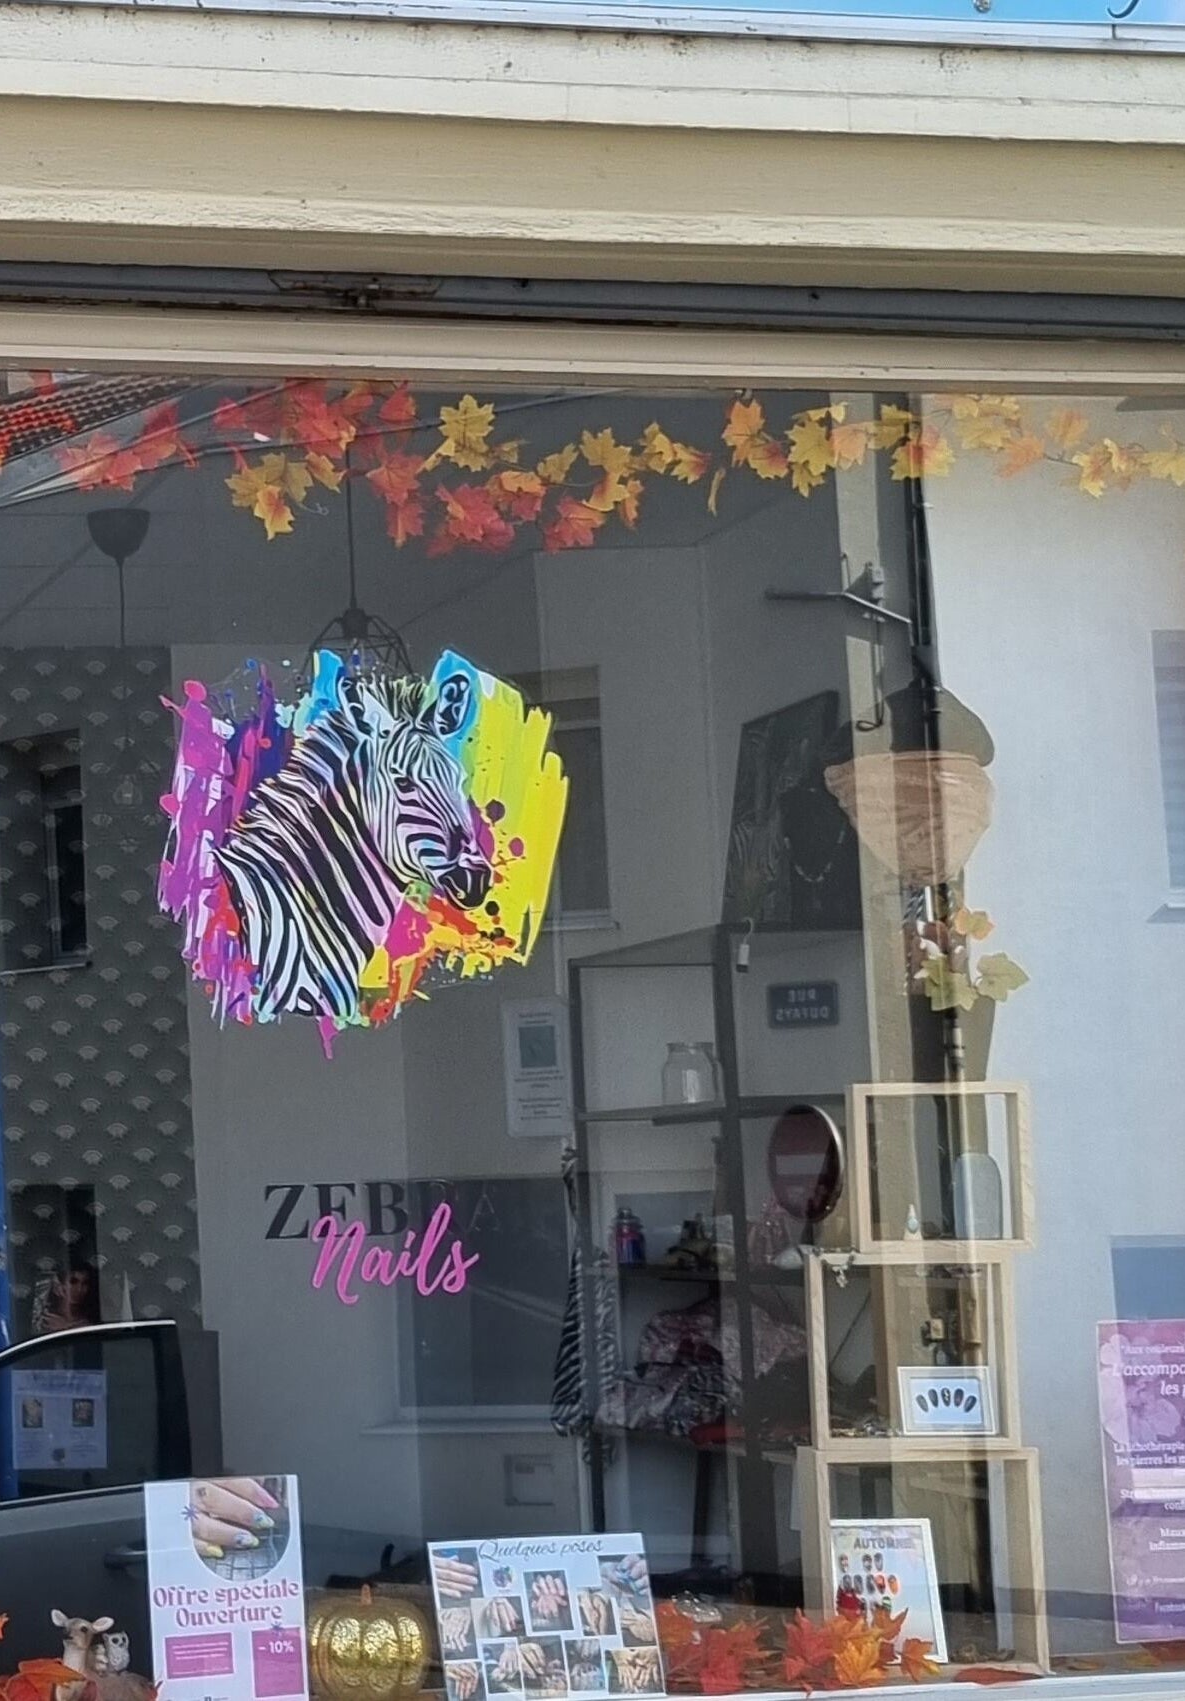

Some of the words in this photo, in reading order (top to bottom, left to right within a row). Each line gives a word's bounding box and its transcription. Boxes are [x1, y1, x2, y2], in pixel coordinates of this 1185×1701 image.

[312, 1202, 479, 1304] Nails
[1160, 1381, 1179, 1395] les
[478, 1540, 556, 1562] Quelques
[153, 1586, 209, 1607] Offre
[214, 1578, 299, 1607] spéciale
[175, 1605, 282, 1627] Ouverture
